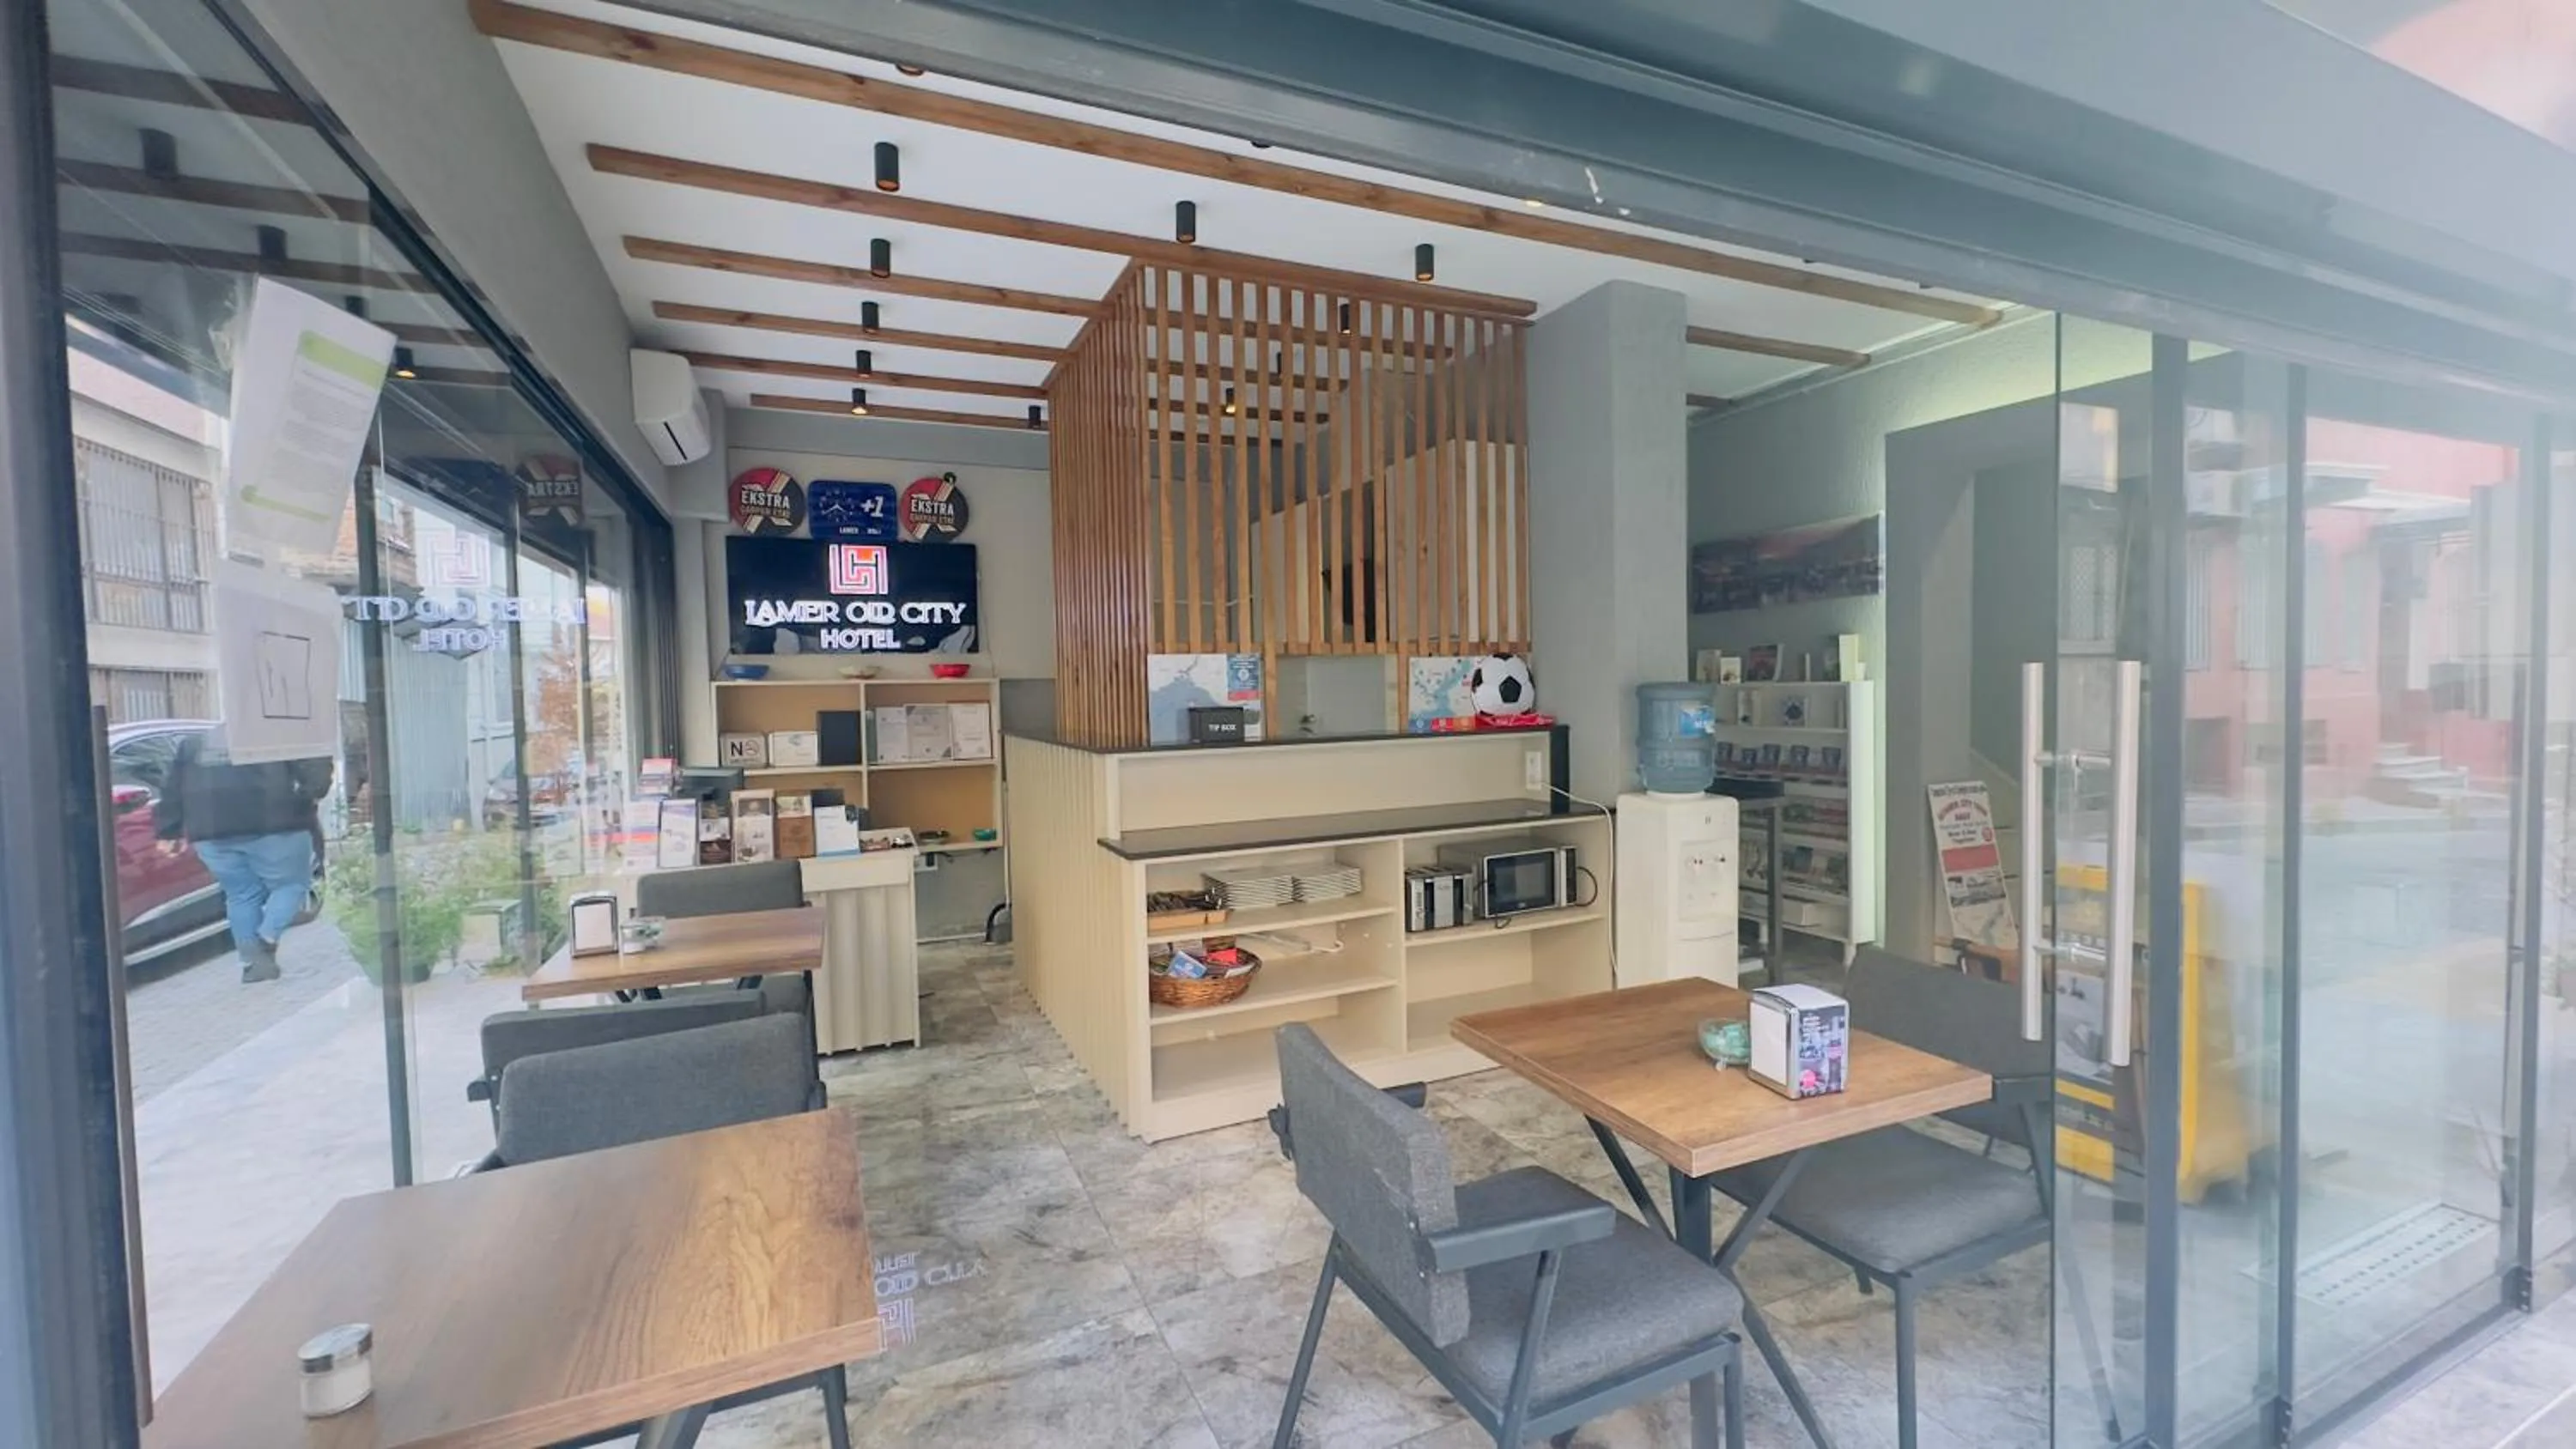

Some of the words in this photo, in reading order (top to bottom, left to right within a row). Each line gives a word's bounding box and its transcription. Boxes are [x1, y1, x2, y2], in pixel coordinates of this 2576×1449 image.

[741, 490, 790, 508] EKSTRA
[860, 495, 884, 518] +1
[910, 499, 954, 515] EKSTRA
[744, 600, 841, 627] LAMER
[900, 602, 967, 624] CITY
[820, 628, 901, 650] HOTEL
